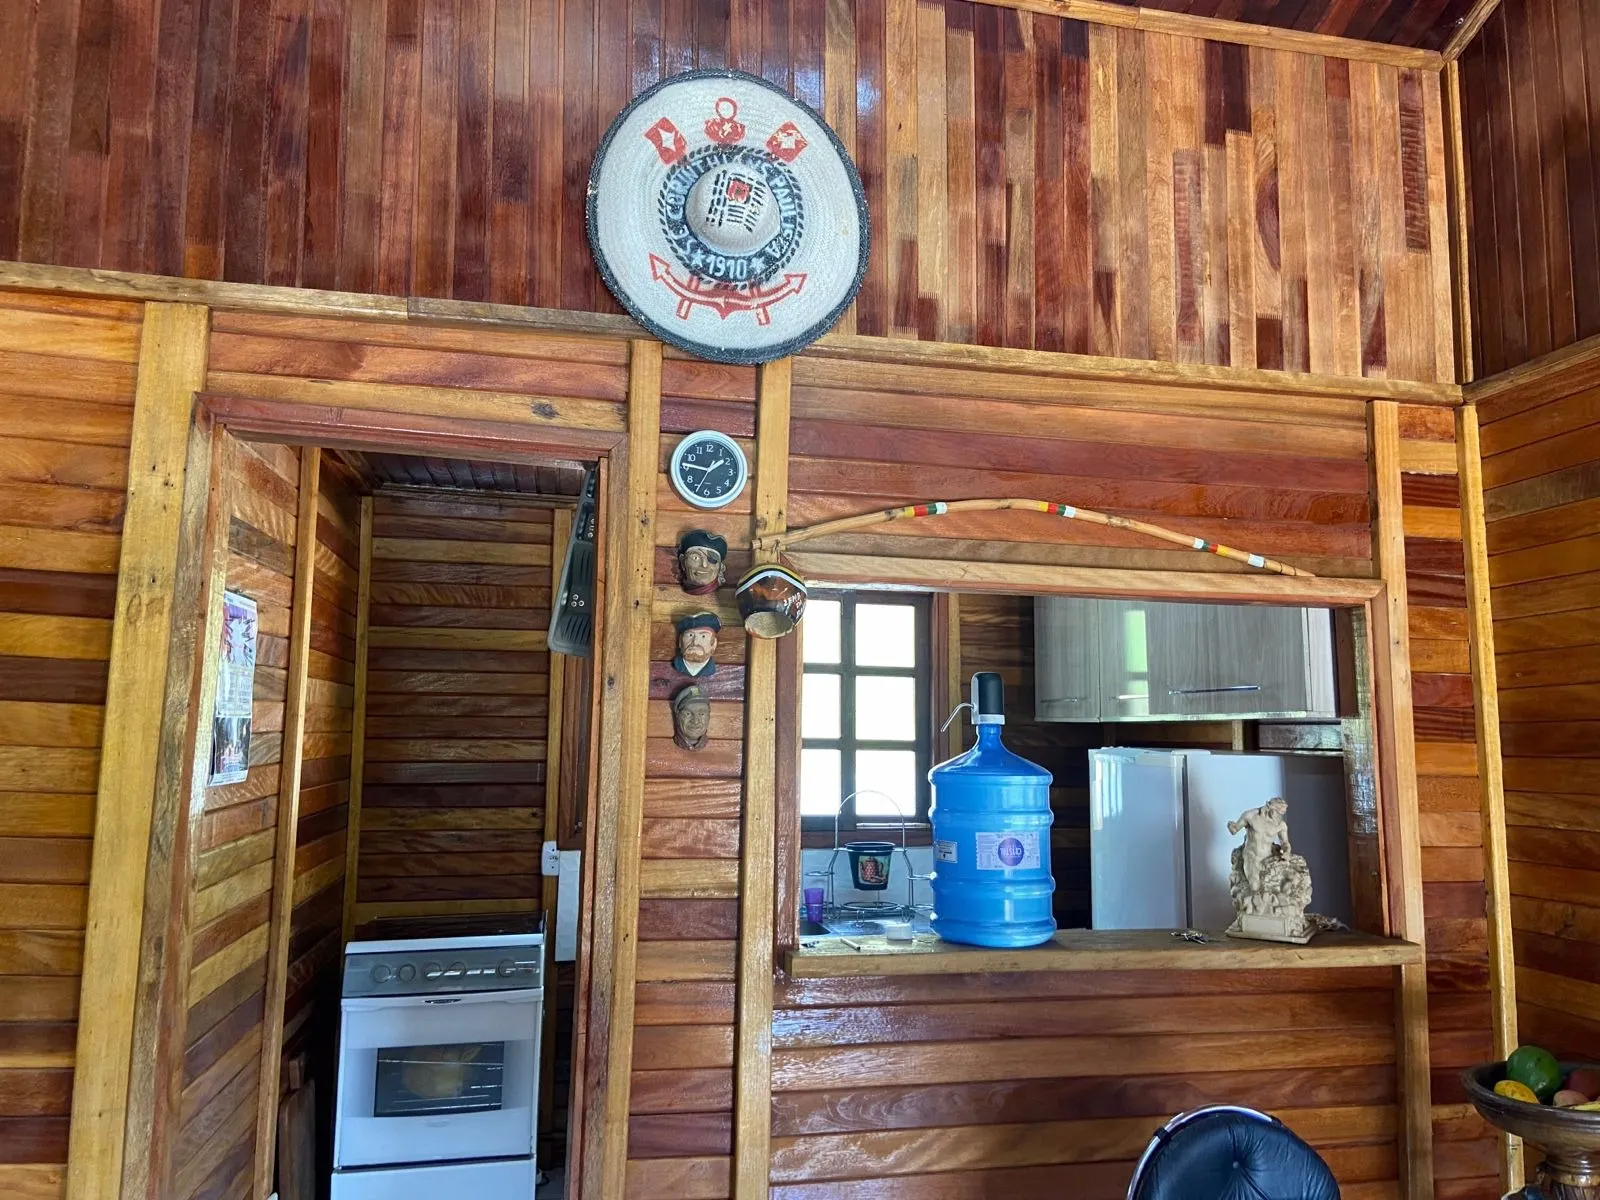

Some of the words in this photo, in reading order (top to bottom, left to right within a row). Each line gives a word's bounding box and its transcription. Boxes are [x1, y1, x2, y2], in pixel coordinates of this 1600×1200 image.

[765, 174, 797, 259] PAULISTA
[705, 254, 747, 280] 1910
[696, 446, 703, 455] 11
[706, 444, 714, 453] 12
[687, 453, 696, 462] 10
[725, 457, 731, 466] 2
[727, 468, 734, 477] 3
[686, 475, 694, 484] 8
[723, 479, 730, 487] 4
[703, 488, 710, 496] 6
[715, 485, 722, 494] 5
